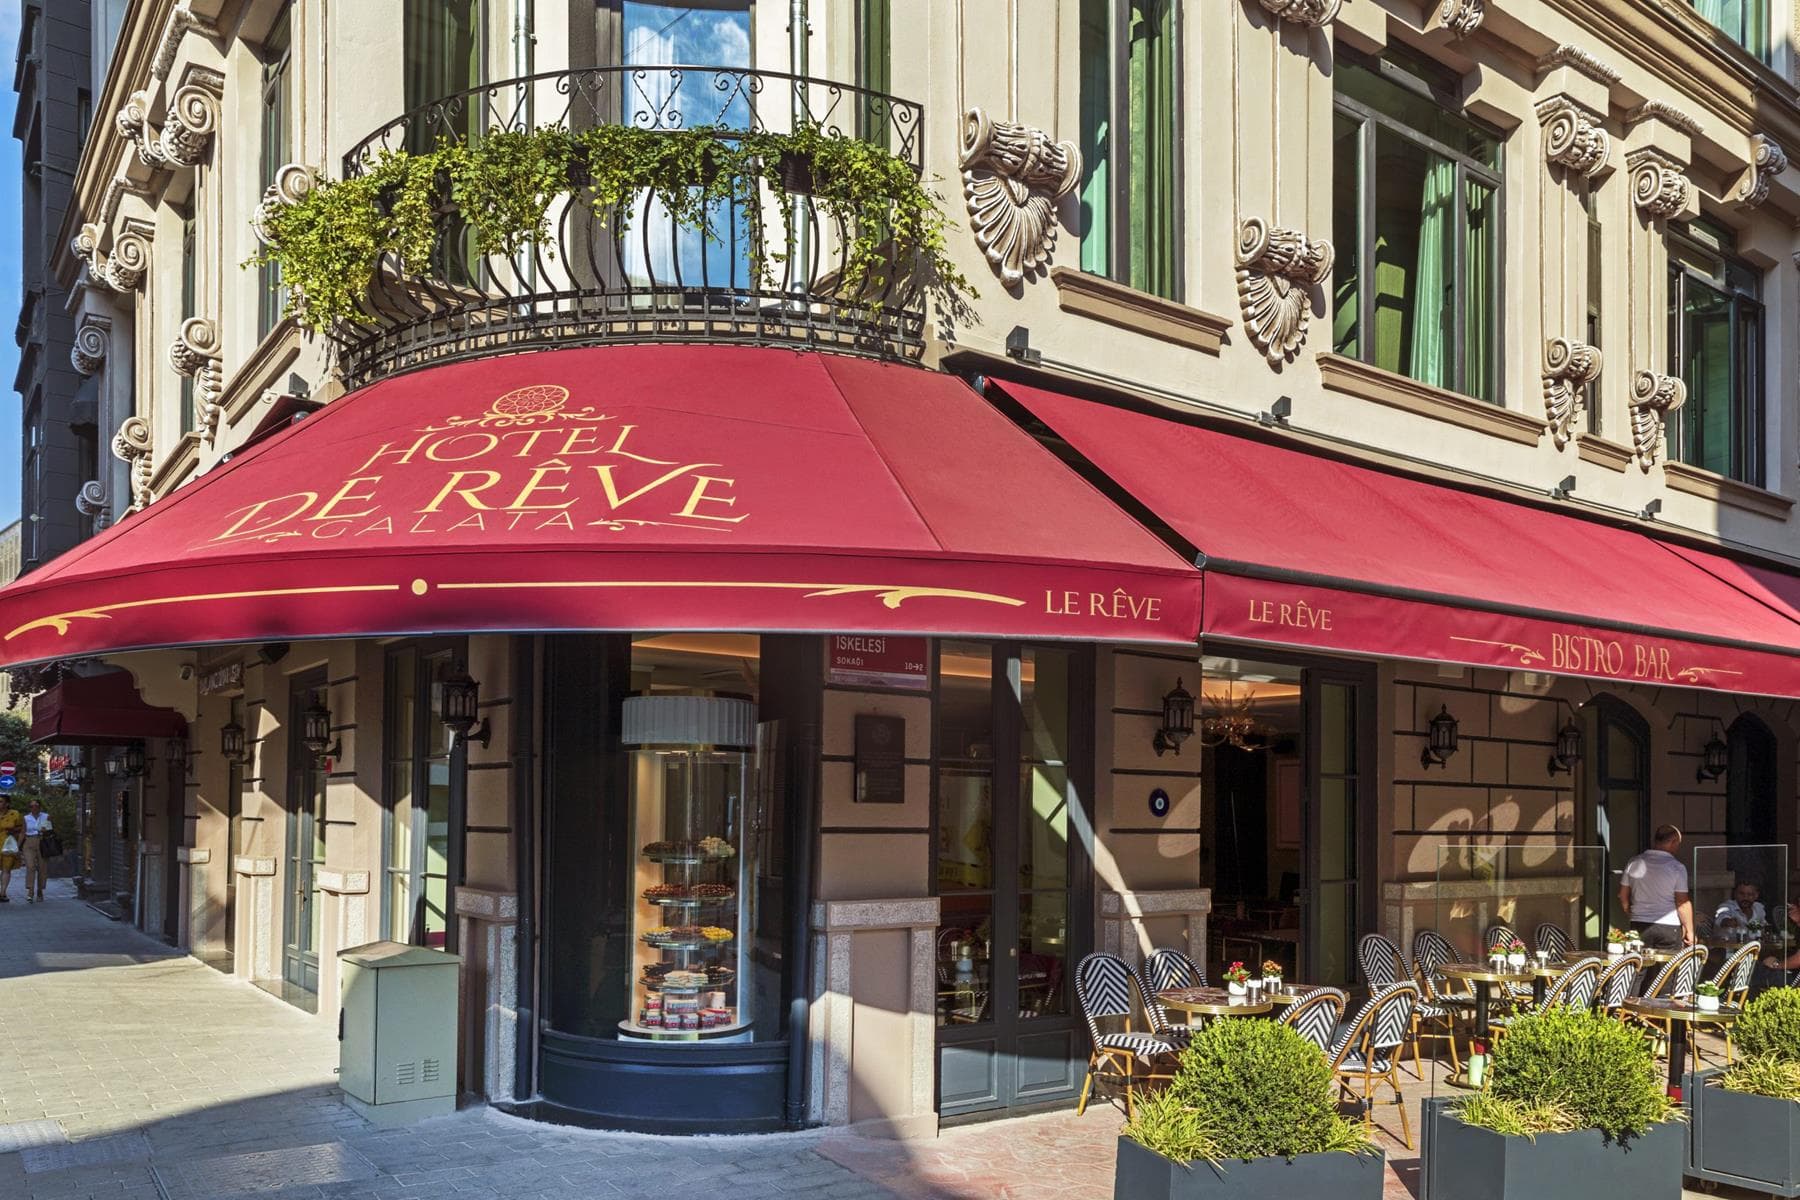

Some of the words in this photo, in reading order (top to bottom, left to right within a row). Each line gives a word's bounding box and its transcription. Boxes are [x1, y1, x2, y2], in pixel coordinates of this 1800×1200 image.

[350, 425, 680, 475] HOTEL
[208, 475, 384, 542] DE
[413, 458, 750, 523] RÊVE
[312, 511, 575, 539] GALATA
[1045, 590, 1081, 616] LE
[1089, 587, 1162, 621] RÊVE
[1249, 599, 1275, 623] LE
[1280, 600, 1333, 631] RÊVE
[1552, 633, 1623, 675] BISTRO
[1635, 644, 1675, 681] BAR
